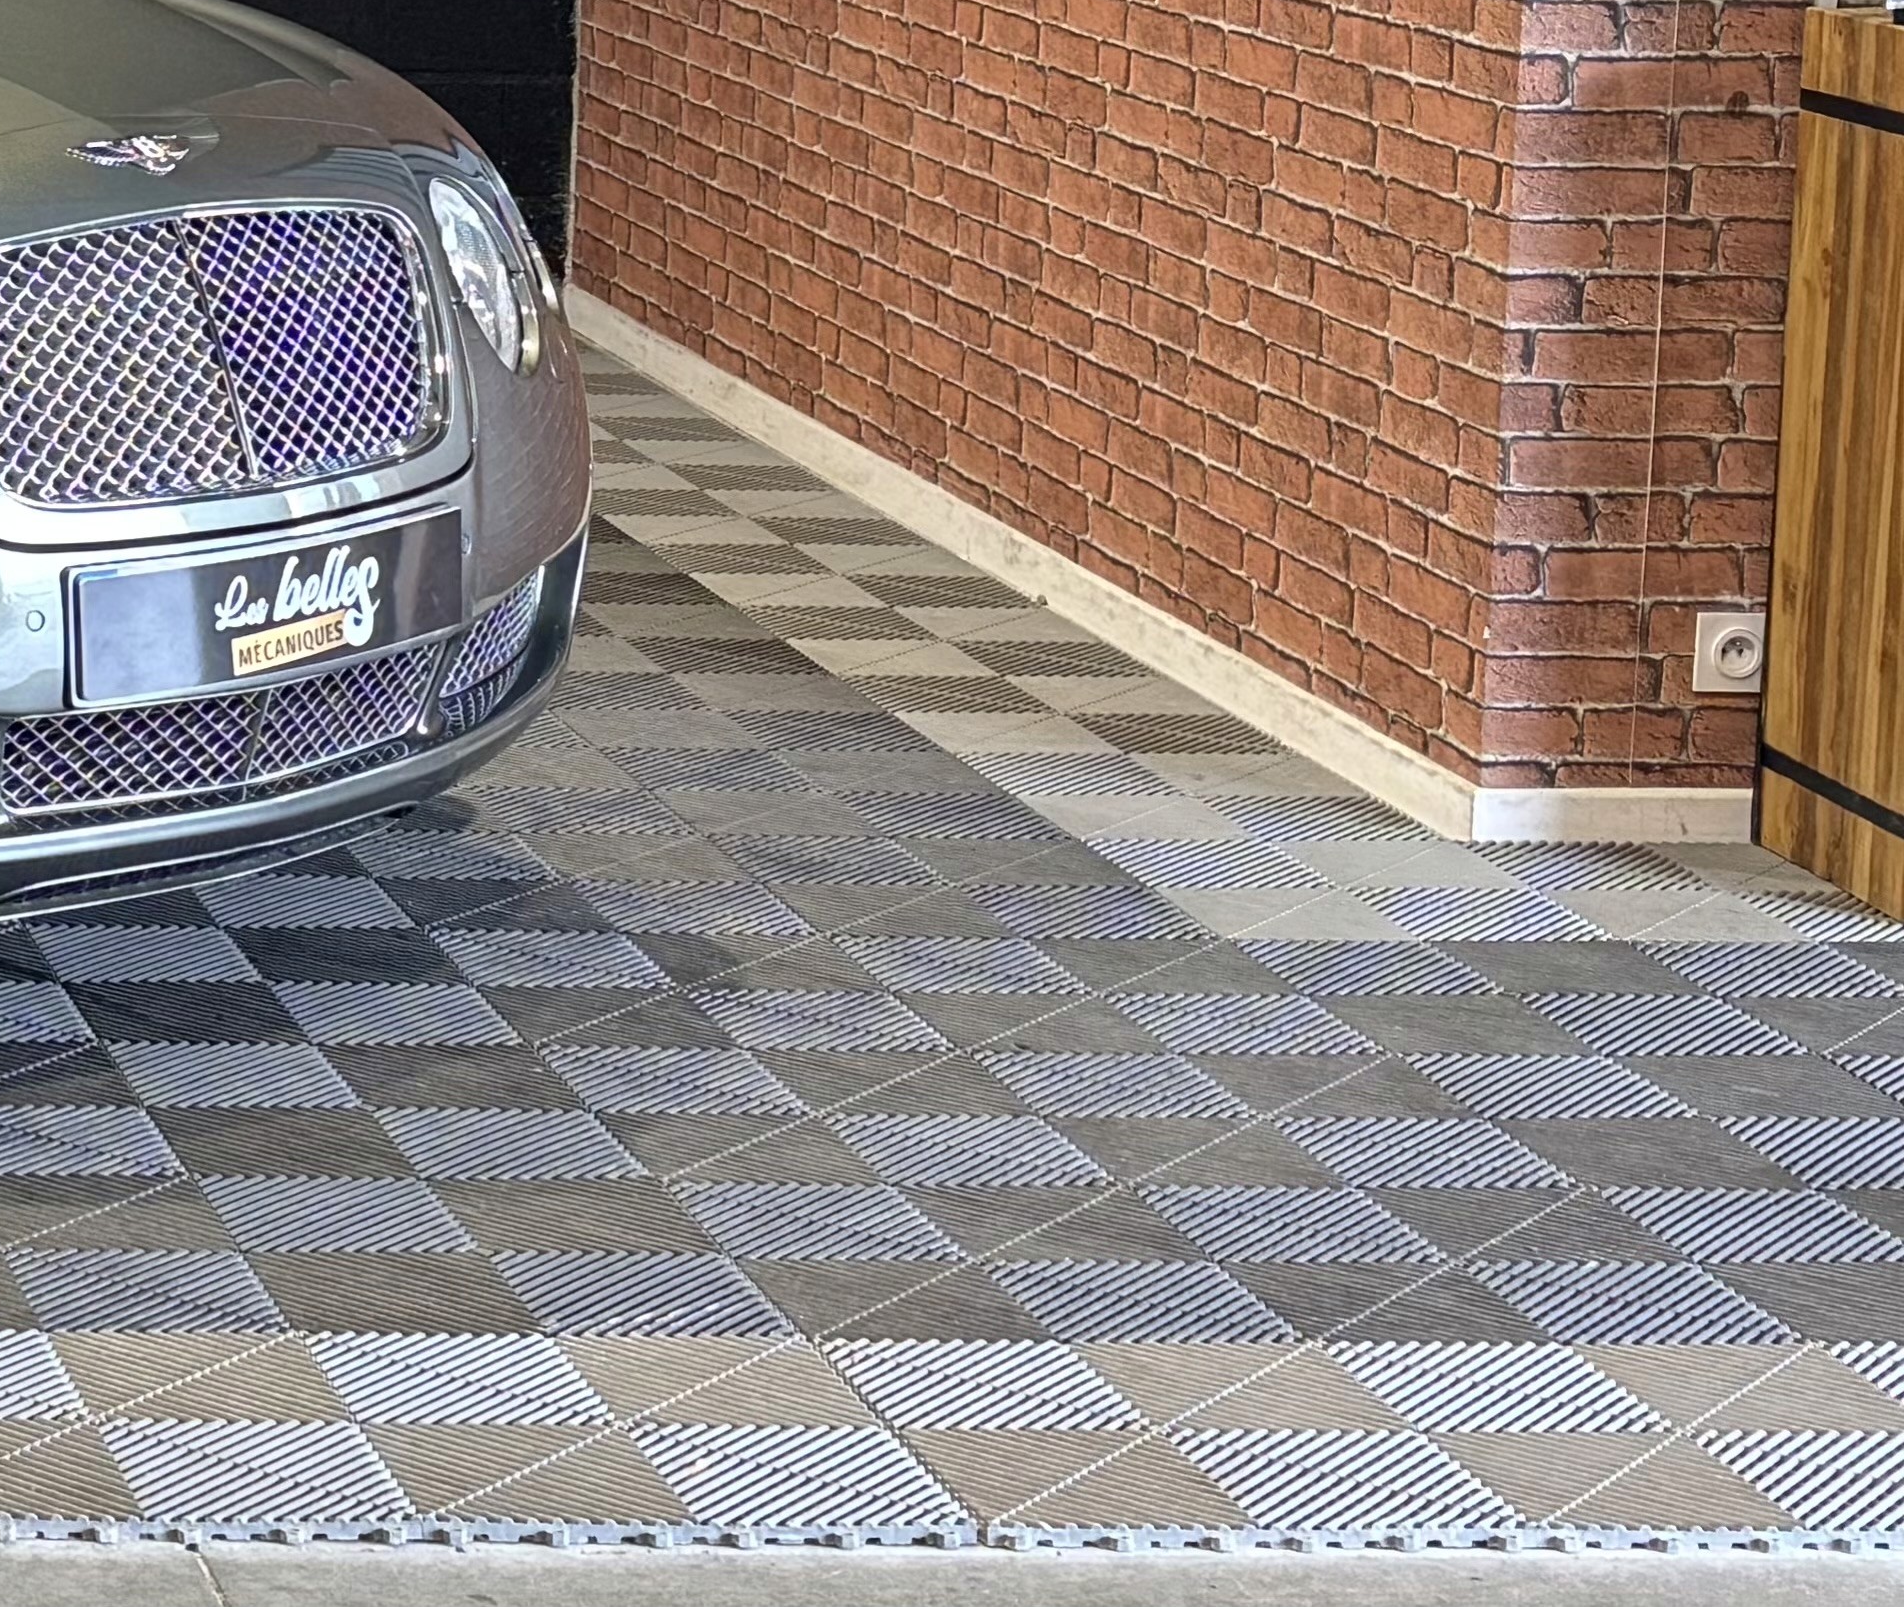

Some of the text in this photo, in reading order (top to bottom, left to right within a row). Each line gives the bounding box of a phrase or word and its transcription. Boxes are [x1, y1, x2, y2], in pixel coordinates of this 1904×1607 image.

[214, 544, 381, 647] Les belles
[238, 619, 344, 668] MÉCANIQUES
